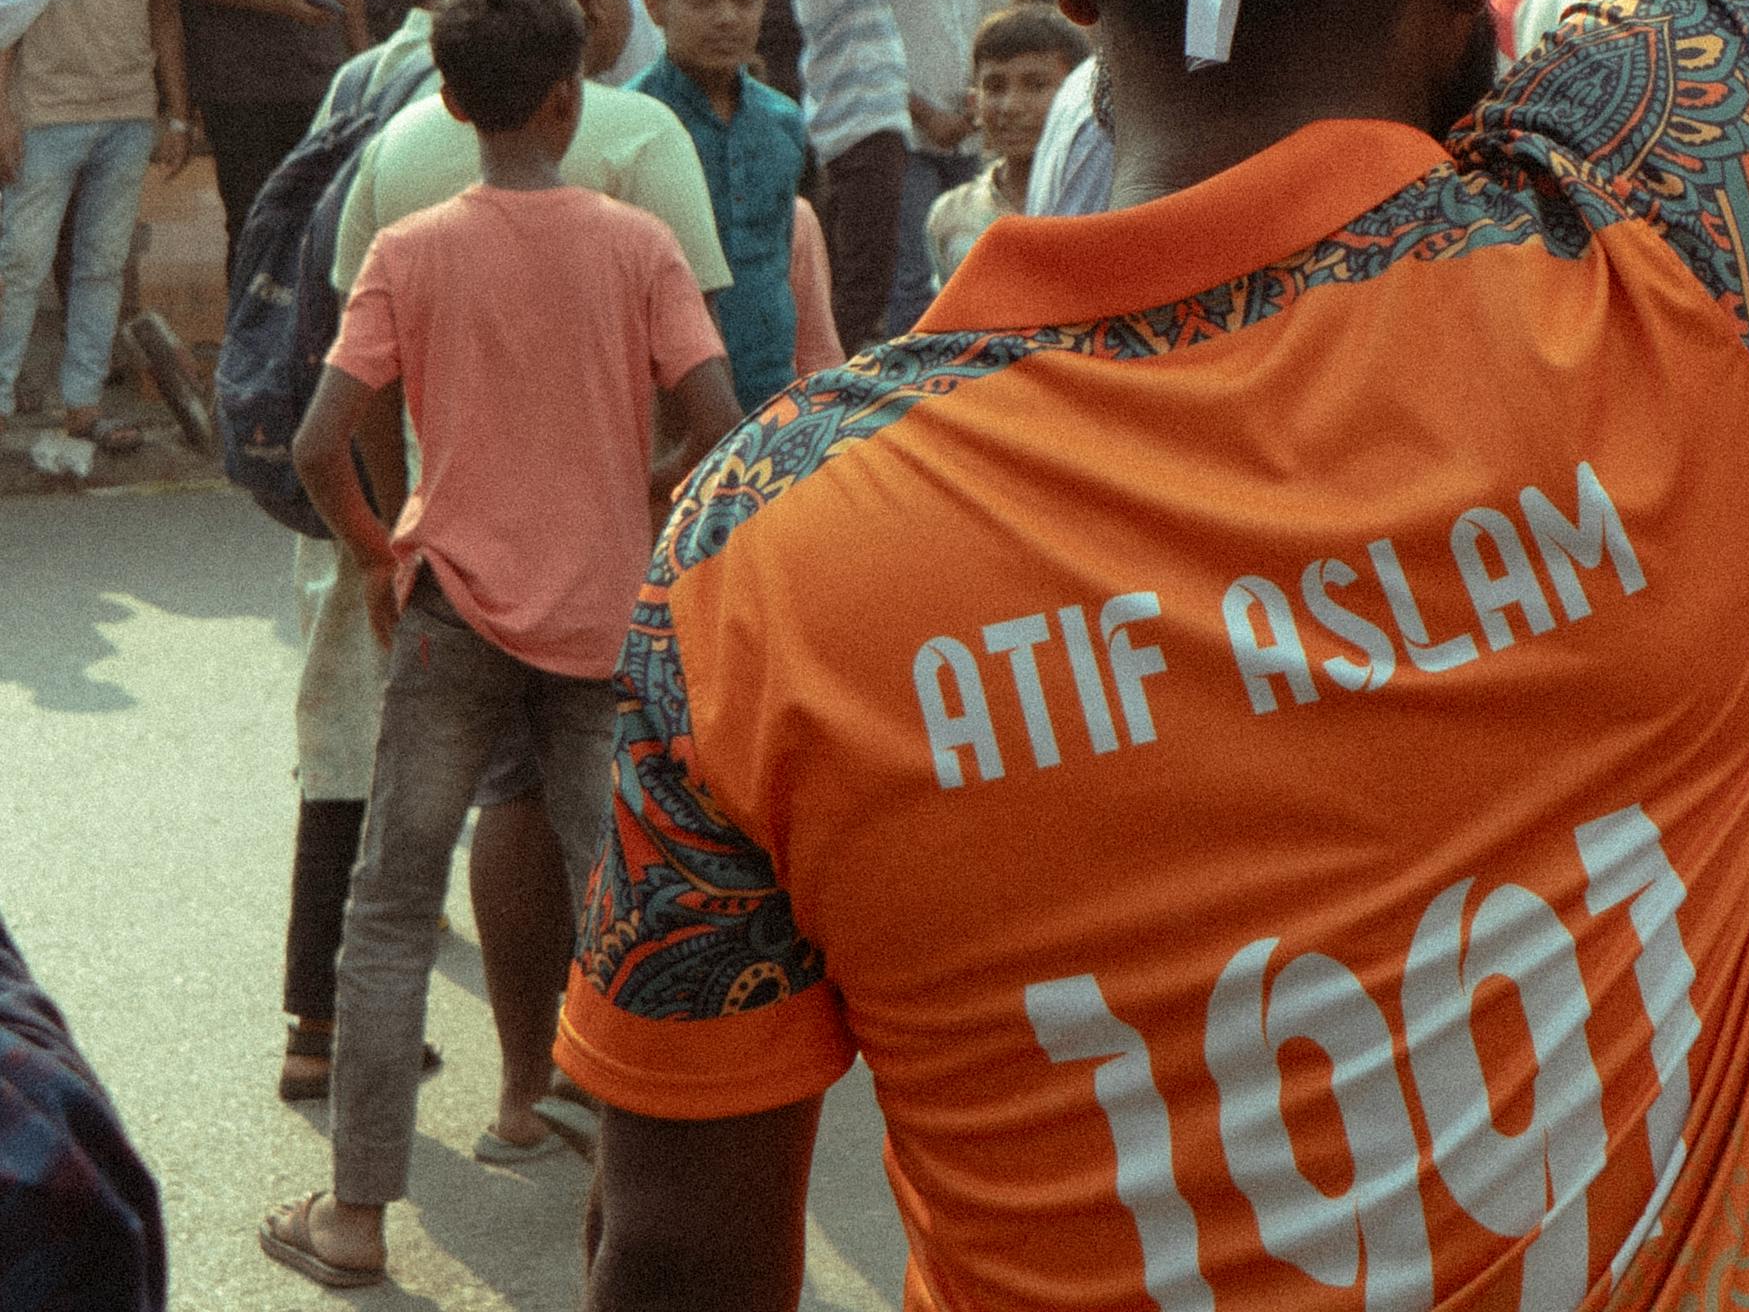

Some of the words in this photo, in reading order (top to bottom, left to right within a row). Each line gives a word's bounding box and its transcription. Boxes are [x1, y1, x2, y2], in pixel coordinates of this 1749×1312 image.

[912, 591, 1169, 789] ATIF
[1220, 460, 1648, 715] ASLAM
[1025, 802, 1703, 1312] 1991
